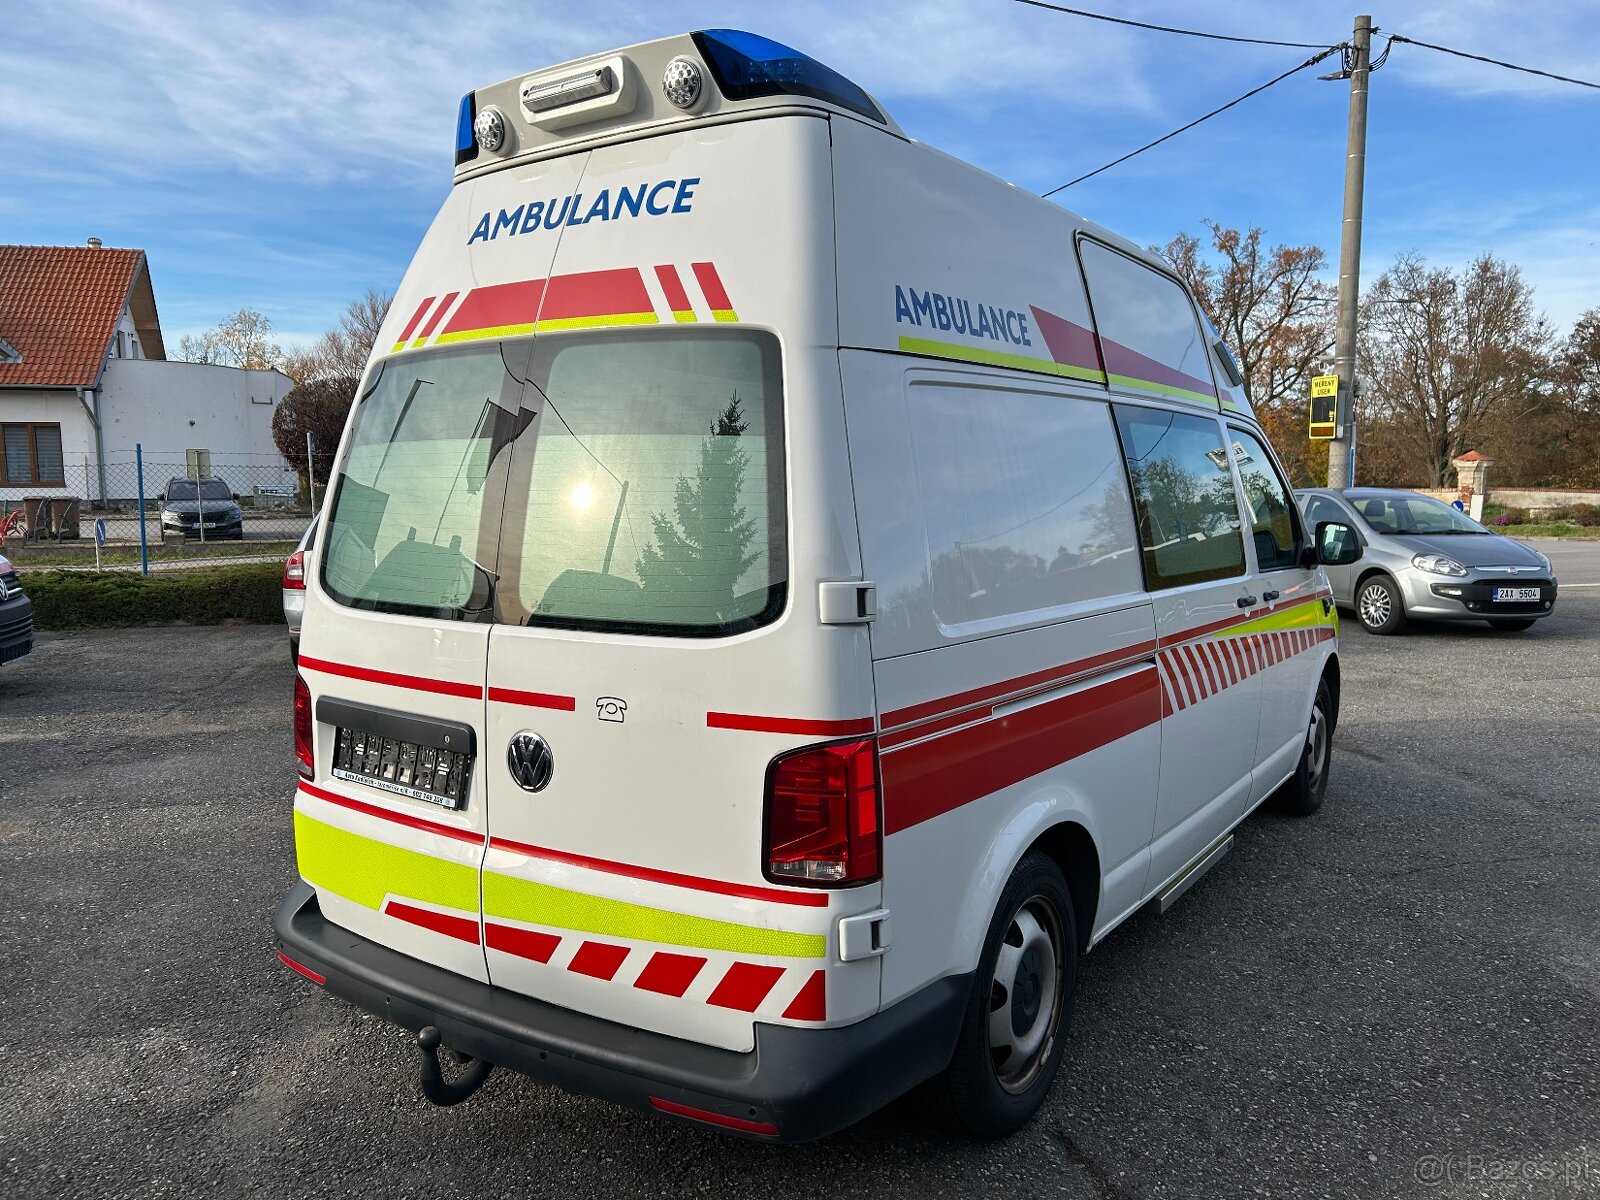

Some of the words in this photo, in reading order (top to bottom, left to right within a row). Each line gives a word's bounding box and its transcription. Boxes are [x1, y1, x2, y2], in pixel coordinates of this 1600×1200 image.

[467, 177, 701, 246] AMBULANCE
[895, 284, 1032, 347] AMBULANCE
[1499, 589, 1514, 599] 2AX
[1519, 589, 1537, 599] 5504
